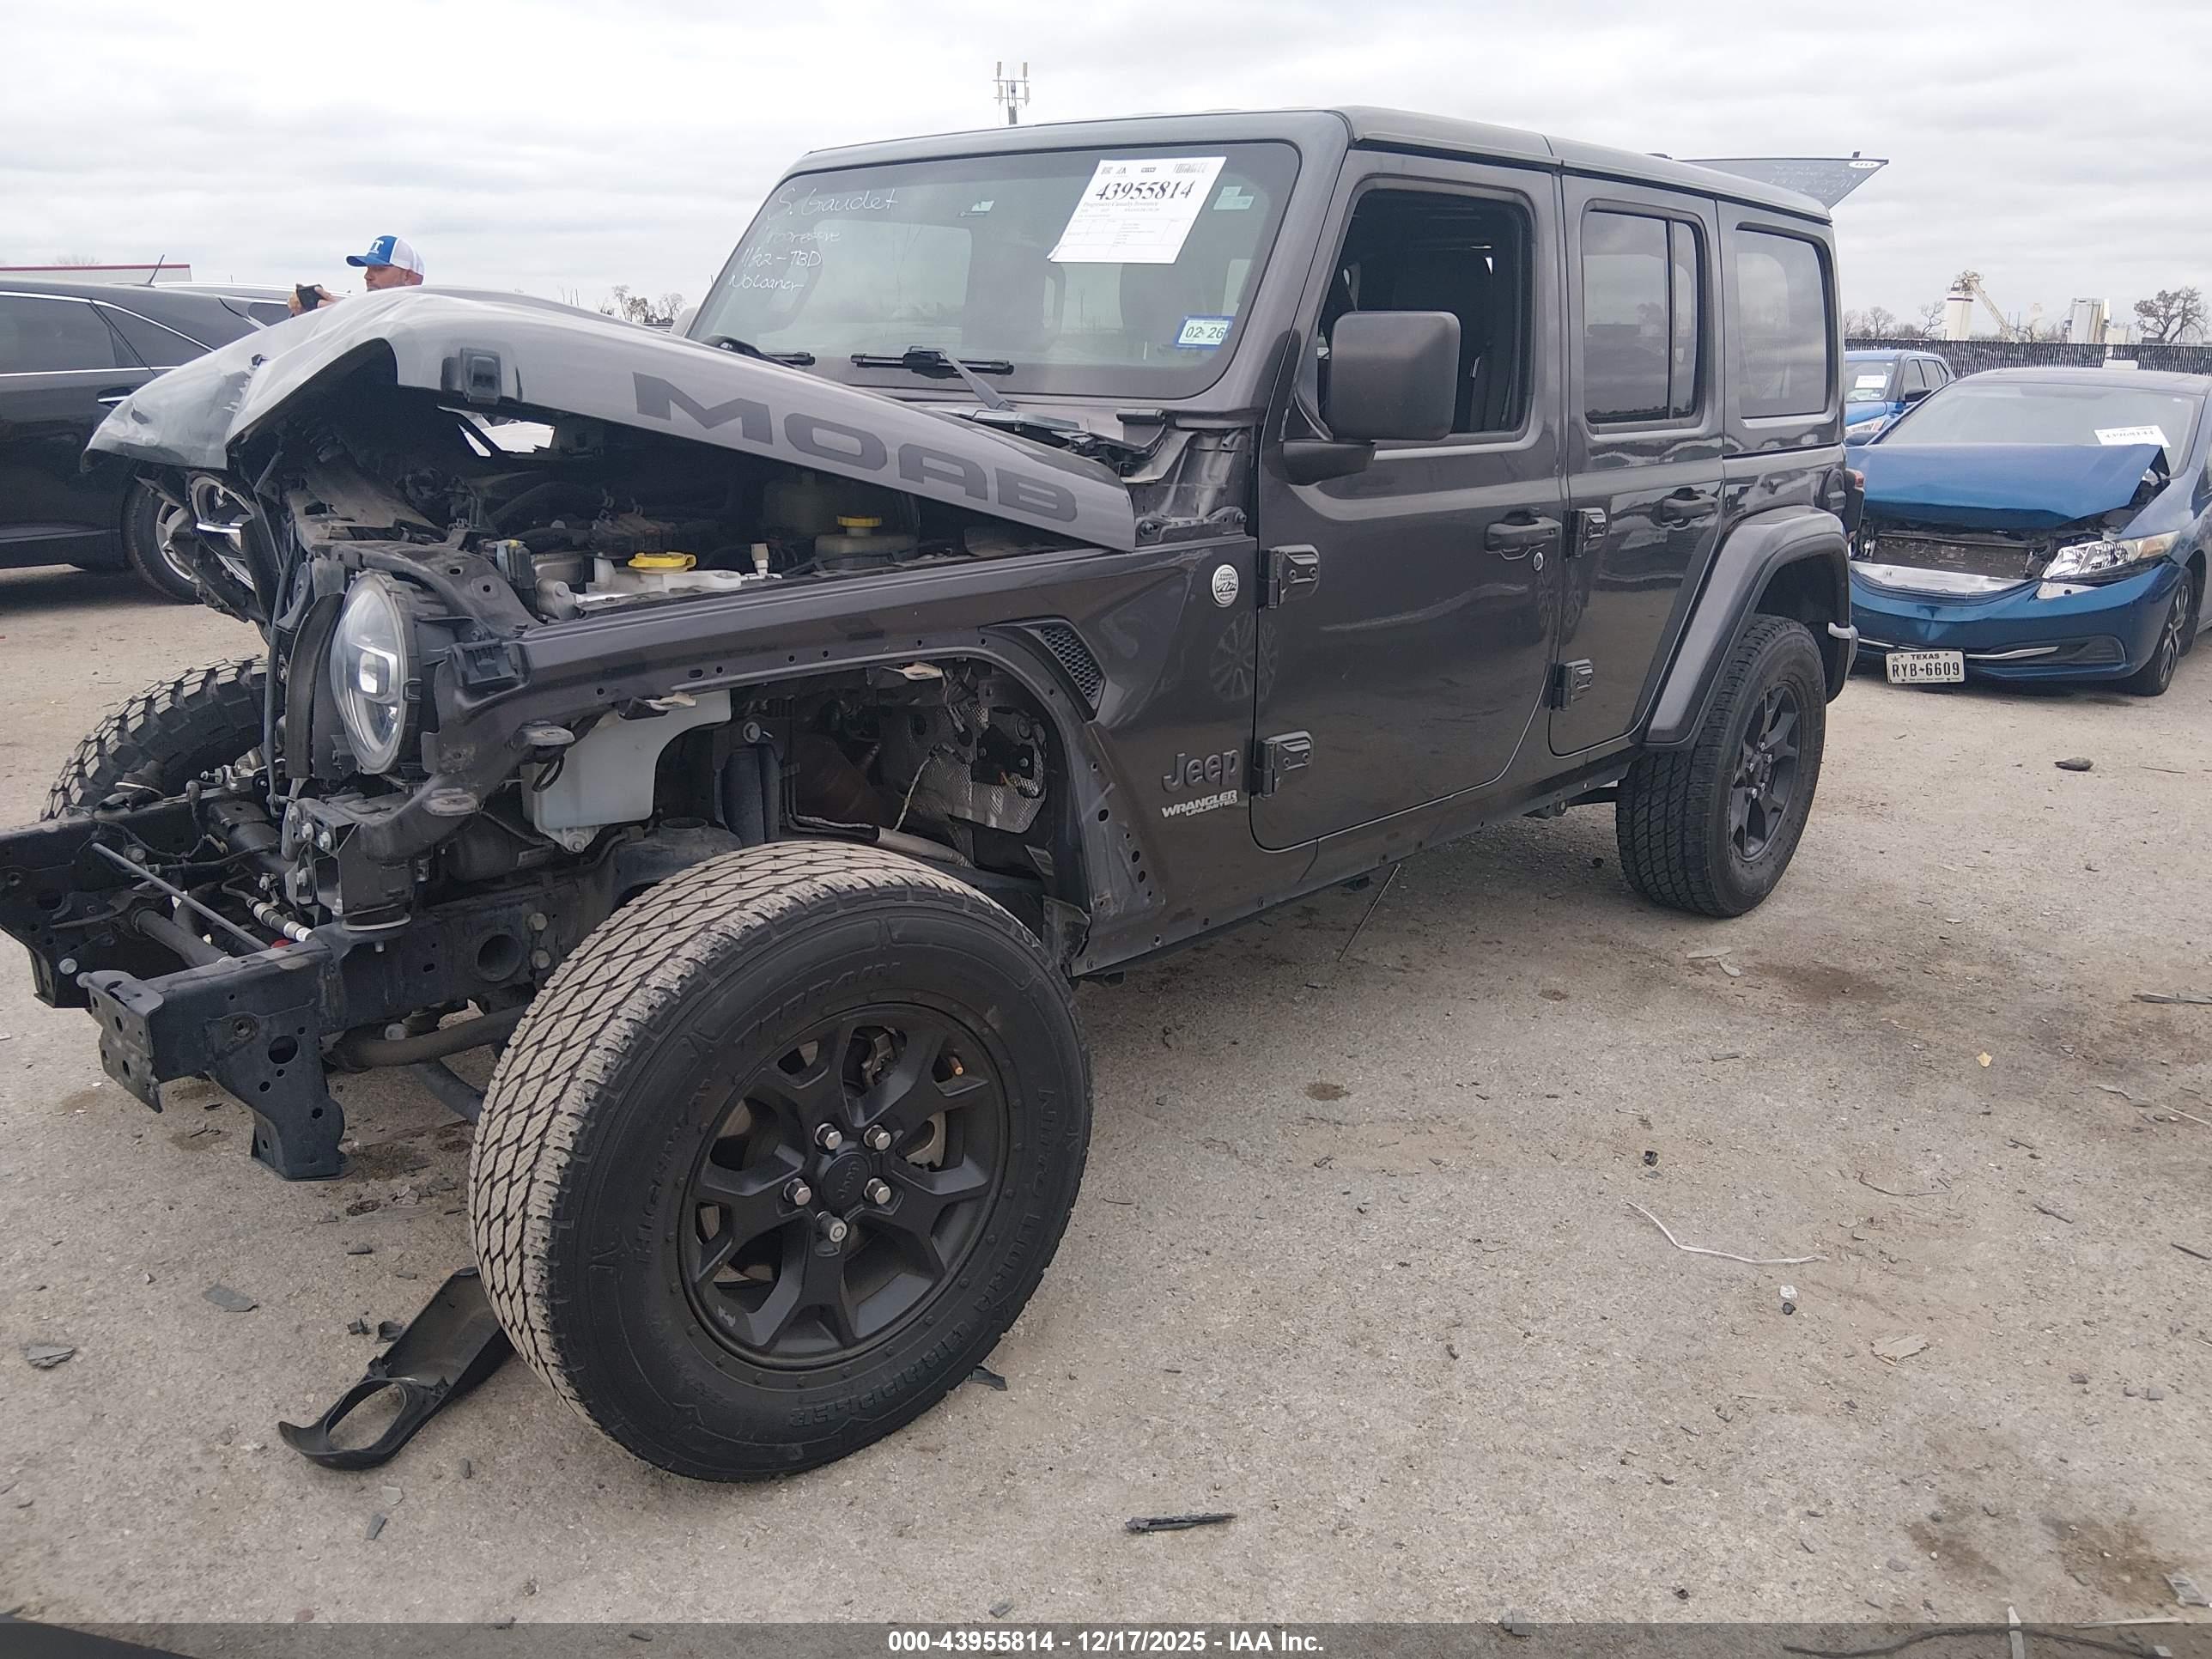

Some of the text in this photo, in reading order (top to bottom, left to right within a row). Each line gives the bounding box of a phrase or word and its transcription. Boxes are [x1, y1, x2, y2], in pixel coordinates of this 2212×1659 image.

[1095, 179, 1195, 200] 43955814
[633, 371, 1078, 522] MOAB
[1162, 749, 1241, 793] Jeep
[1161, 789, 1237, 817] WRANGLER
[1185, 798, 1237, 817] UNLIMITED
